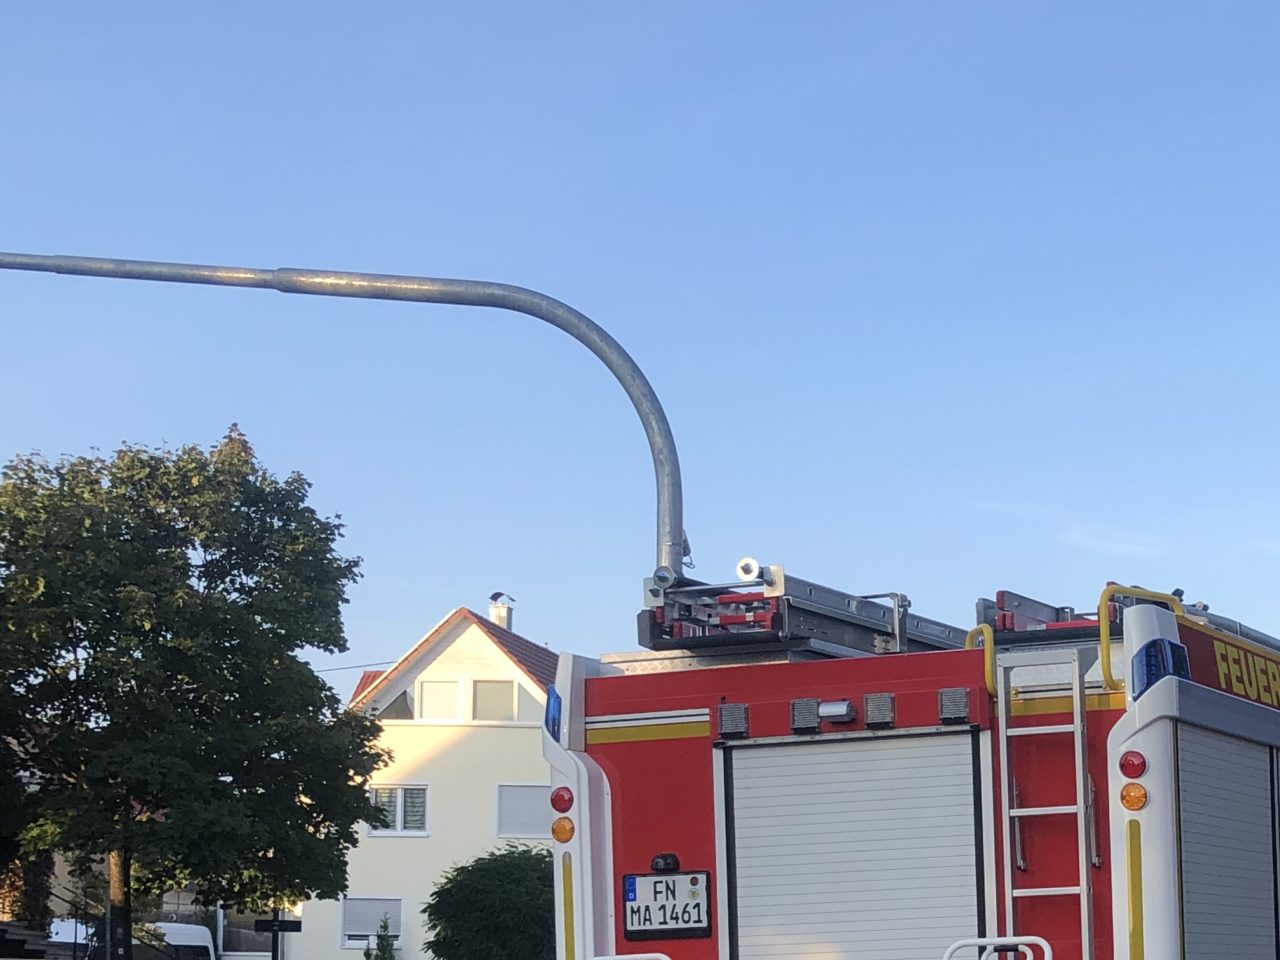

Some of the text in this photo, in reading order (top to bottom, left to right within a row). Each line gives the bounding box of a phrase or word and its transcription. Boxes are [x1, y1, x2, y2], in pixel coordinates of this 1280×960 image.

[653, 880, 677, 902] FN
[630, 902, 703, 926] MA 1461
